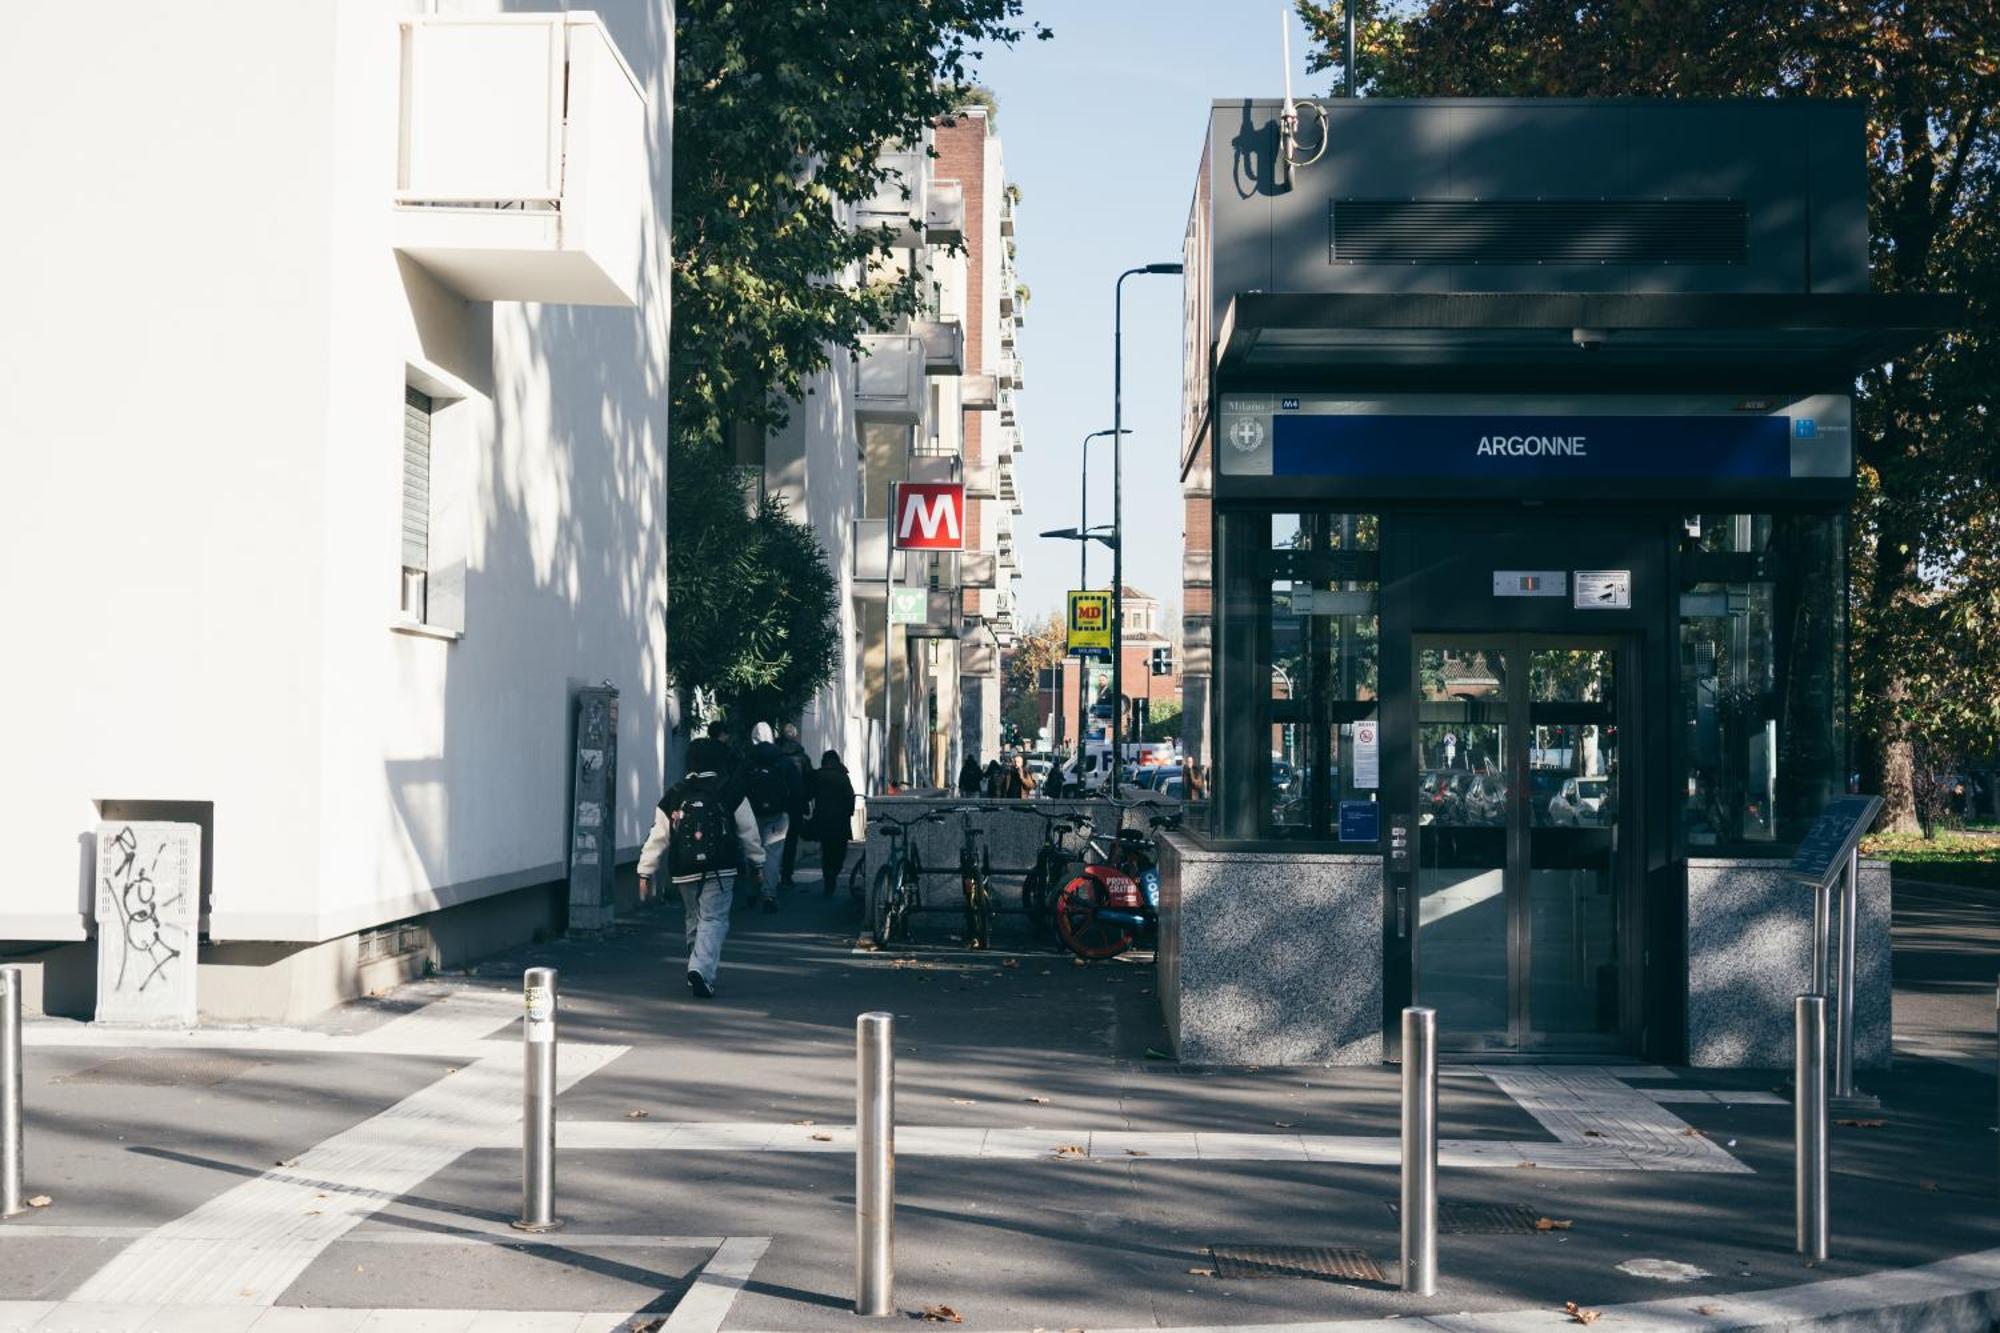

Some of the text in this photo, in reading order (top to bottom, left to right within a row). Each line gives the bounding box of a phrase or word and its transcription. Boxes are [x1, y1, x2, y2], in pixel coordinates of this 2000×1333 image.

[1229, 400, 1265, 411] Milano
[1283, 400, 1298, 408] M4
[1476, 436, 1587, 456] ARGONNE
[899, 493, 961, 540] M
[1078, 606, 1101, 619] MD
